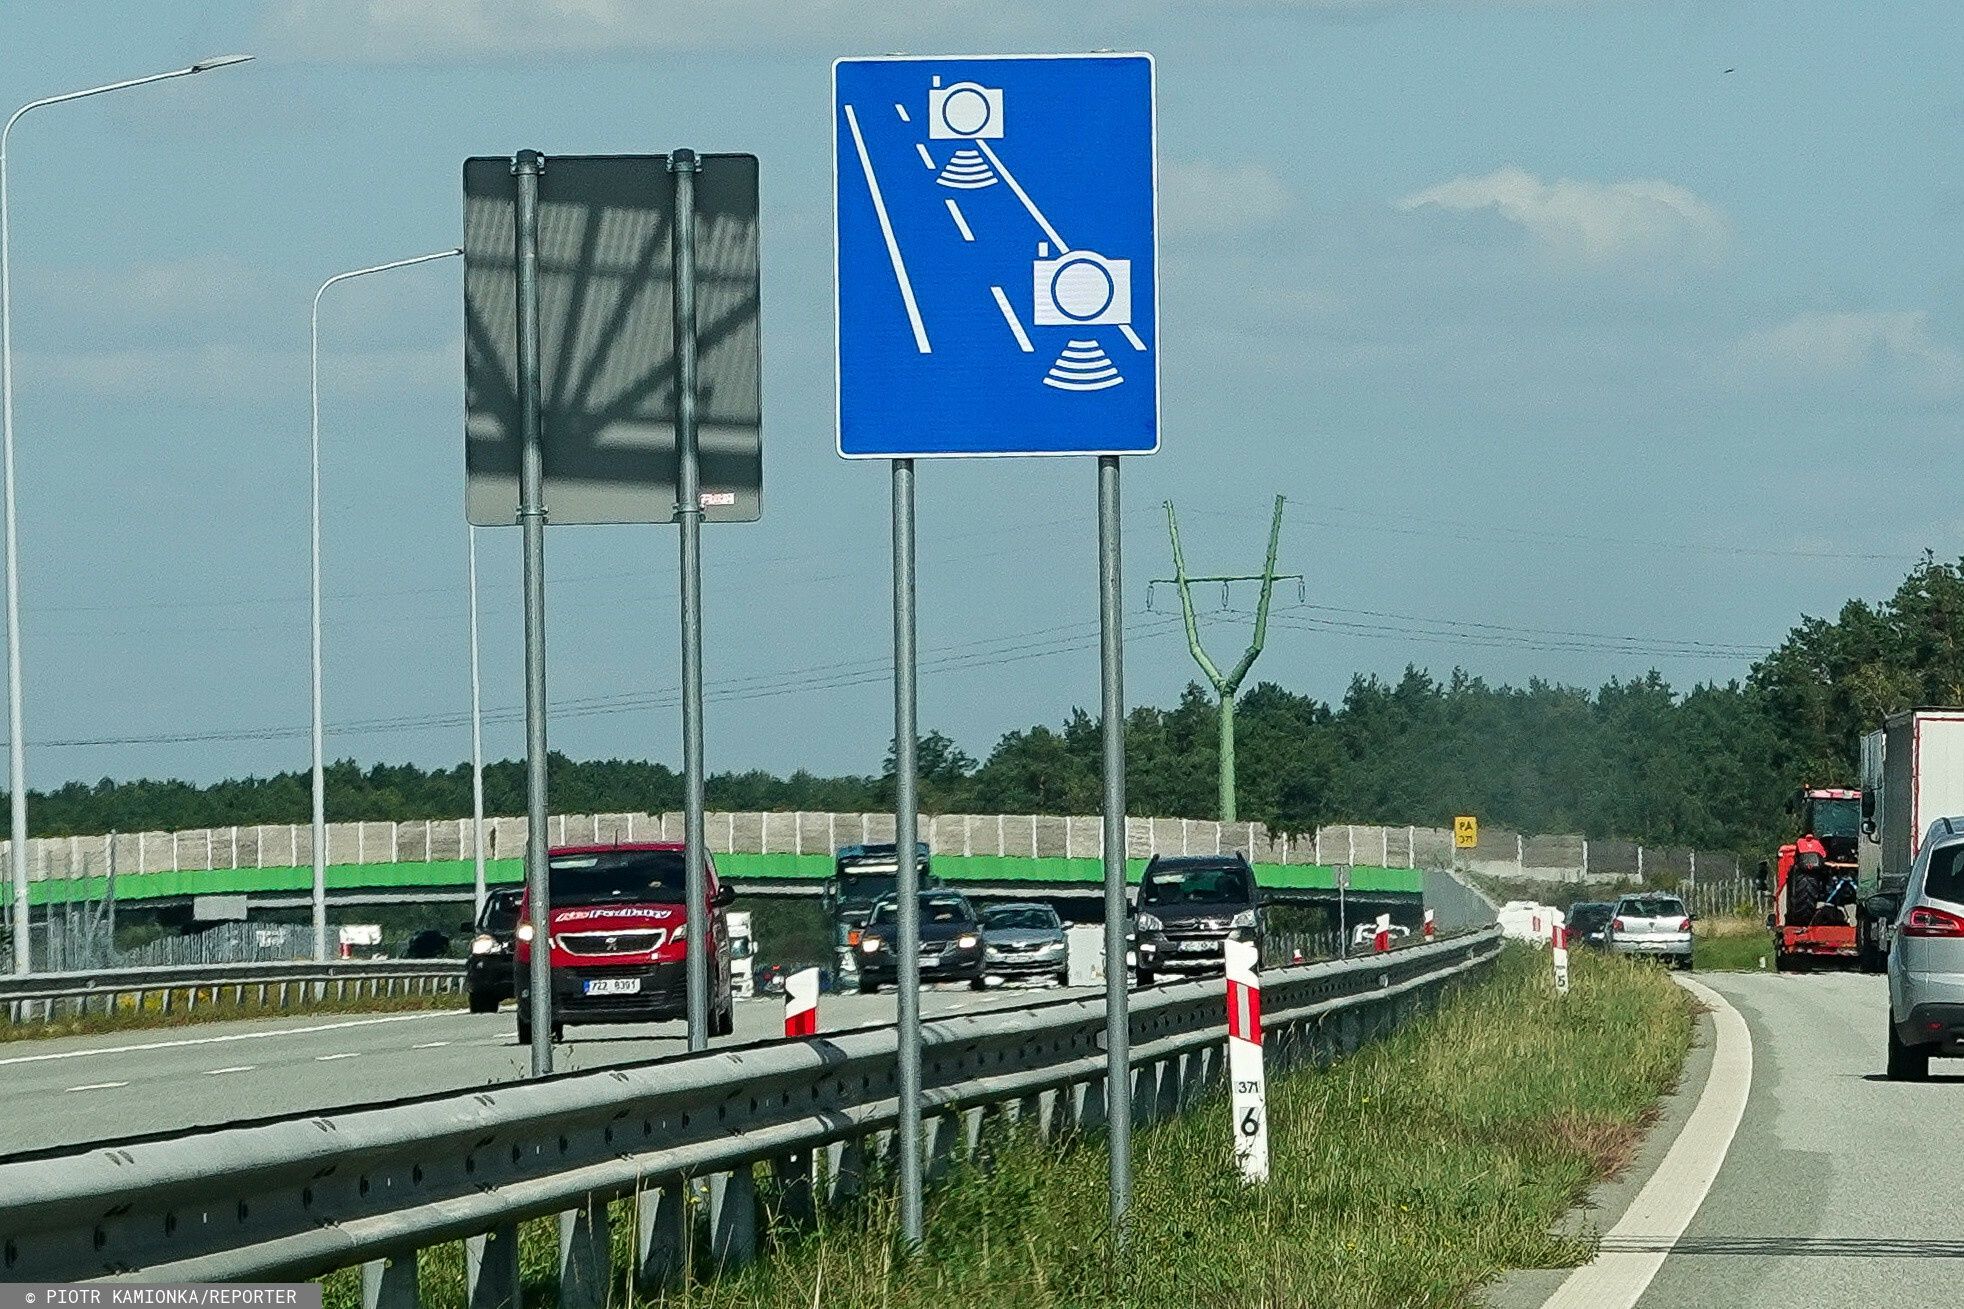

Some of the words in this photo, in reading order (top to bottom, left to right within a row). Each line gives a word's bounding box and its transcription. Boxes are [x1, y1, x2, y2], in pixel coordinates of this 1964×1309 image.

[1459, 821, 1473, 831] PA
[1557, 975, 1566, 987] 5
[1238, 1081, 1259, 1094] 371
[1241, 1107, 1260, 1136] 6
